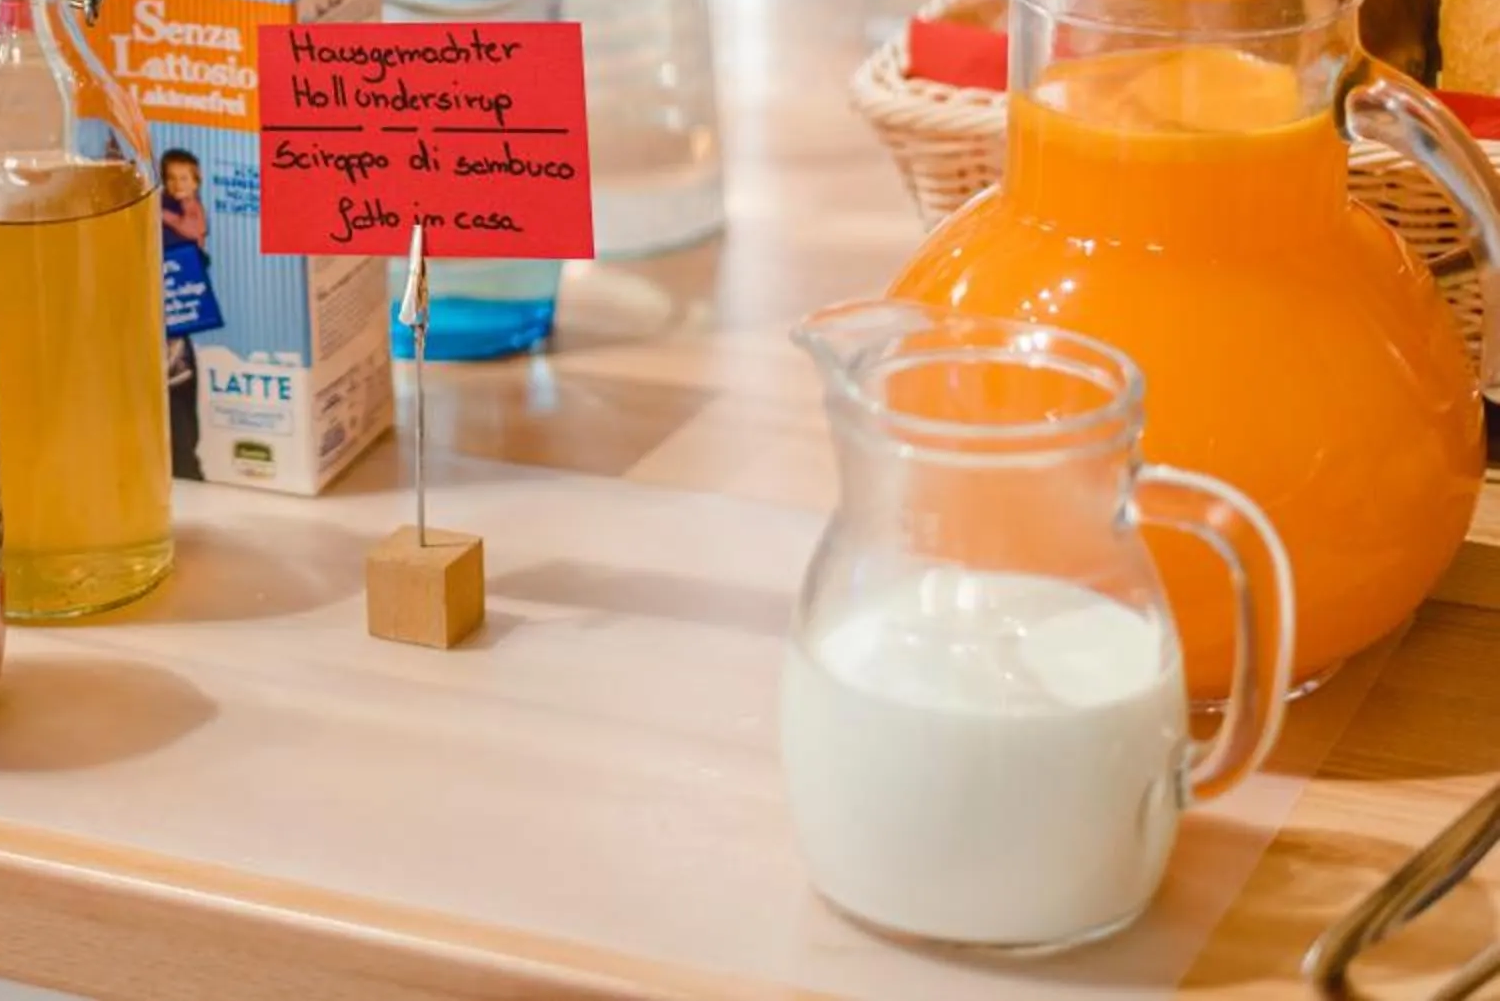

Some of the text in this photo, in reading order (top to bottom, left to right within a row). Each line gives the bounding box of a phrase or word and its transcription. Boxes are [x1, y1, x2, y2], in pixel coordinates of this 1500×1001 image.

[109, 33, 259, 90] Lattosio
[289, 28, 522, 83] Hausgemachter
[291, 74, 514, 128] Hollundersirup
[271, 139, 576, 184] Sciroppo di sambuco
[330, 197, 525, 243] fatto in casa
[208, 366, 292, 400] LATTE
